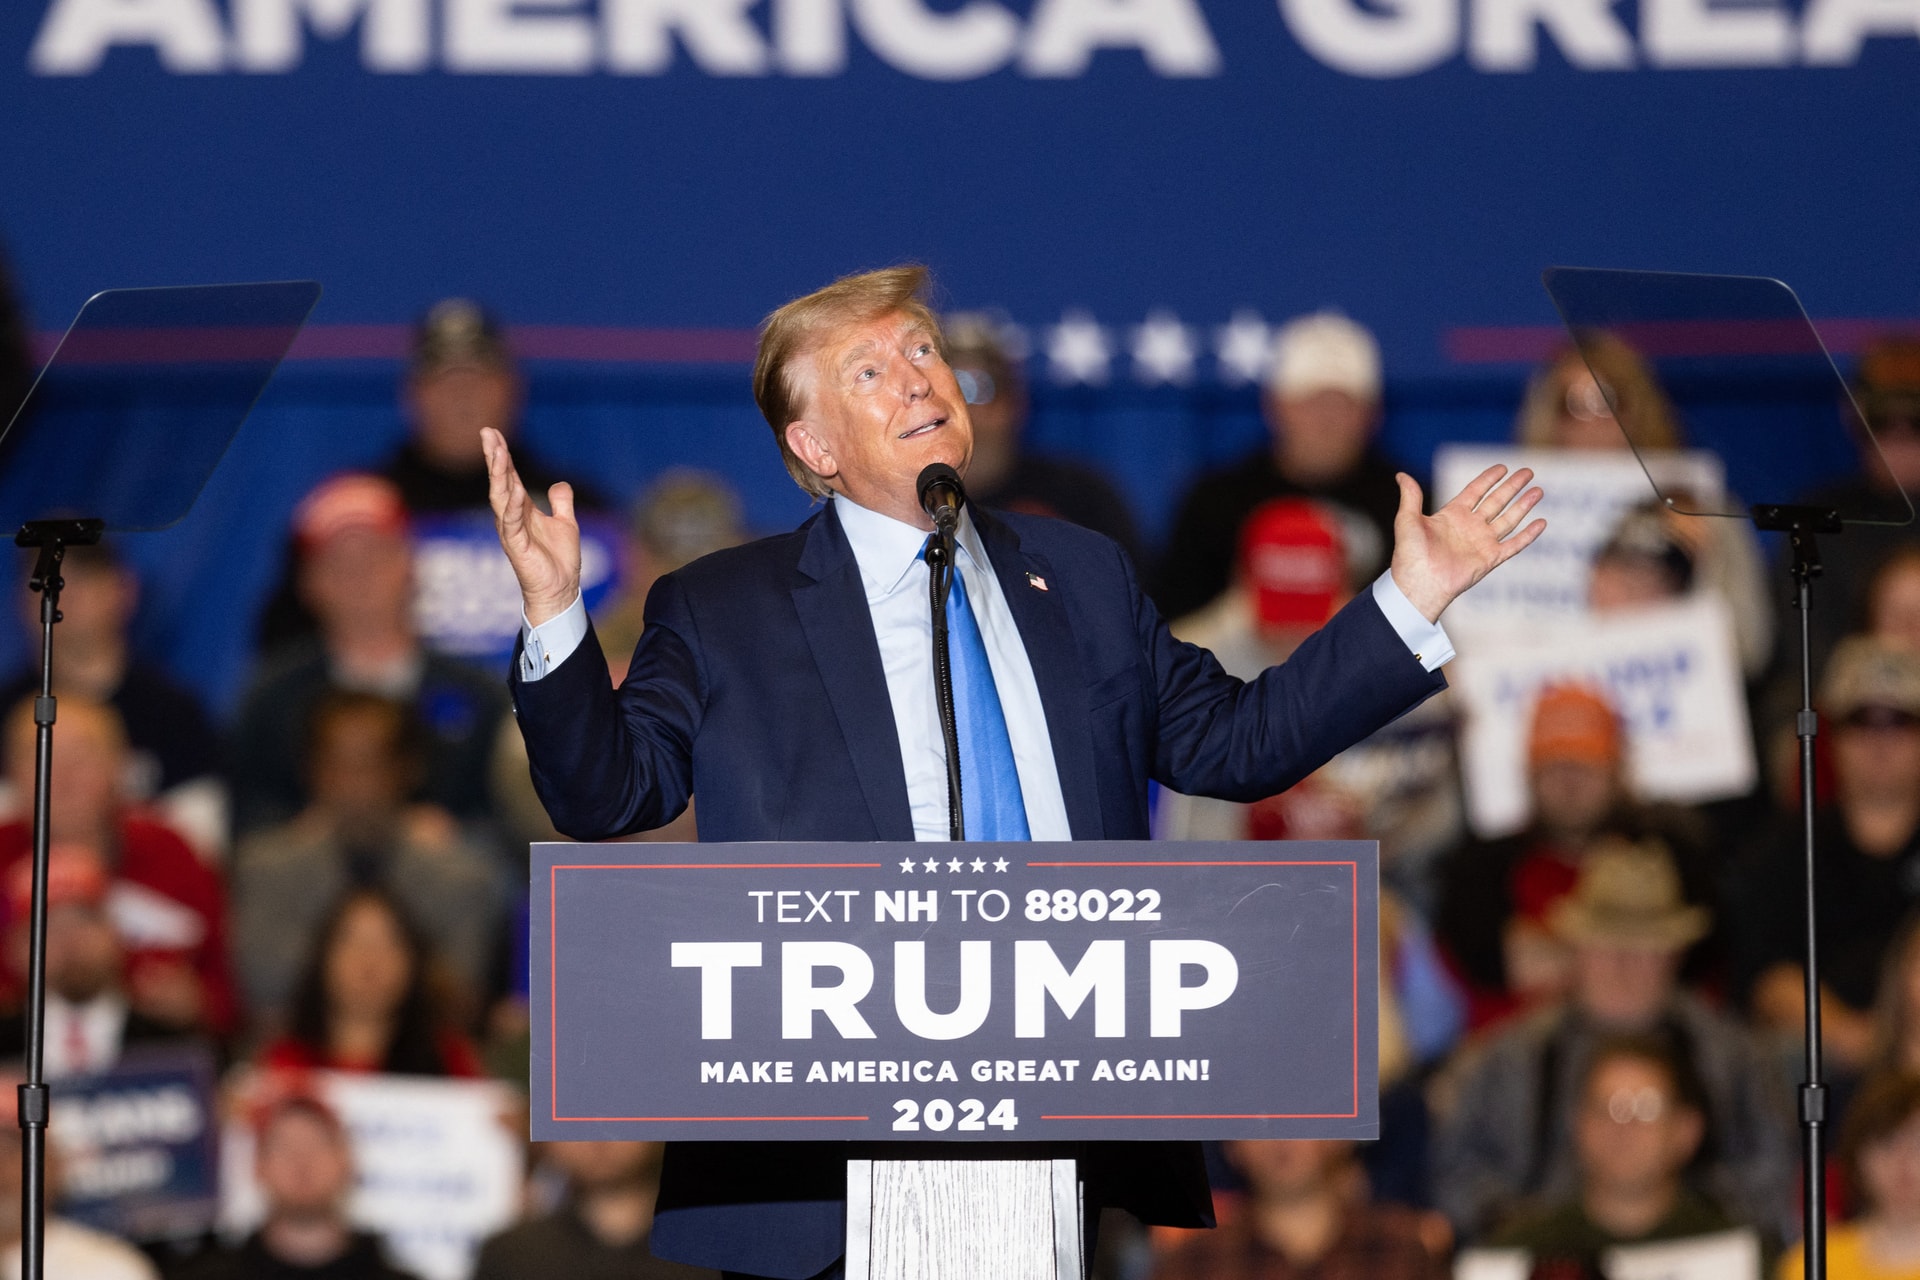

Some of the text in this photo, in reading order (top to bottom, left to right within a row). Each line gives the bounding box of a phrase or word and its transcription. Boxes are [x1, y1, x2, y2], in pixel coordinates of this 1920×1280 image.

[747, 888, 1162, 923] TEXT NH TO 88022
[670, 939, 1240, 1041] TRUMP
[700, 1059, 1210, 1084] MAKE AMERICA GREAT AGAIN!
[891, 1098, 1019, 1132] 2024
